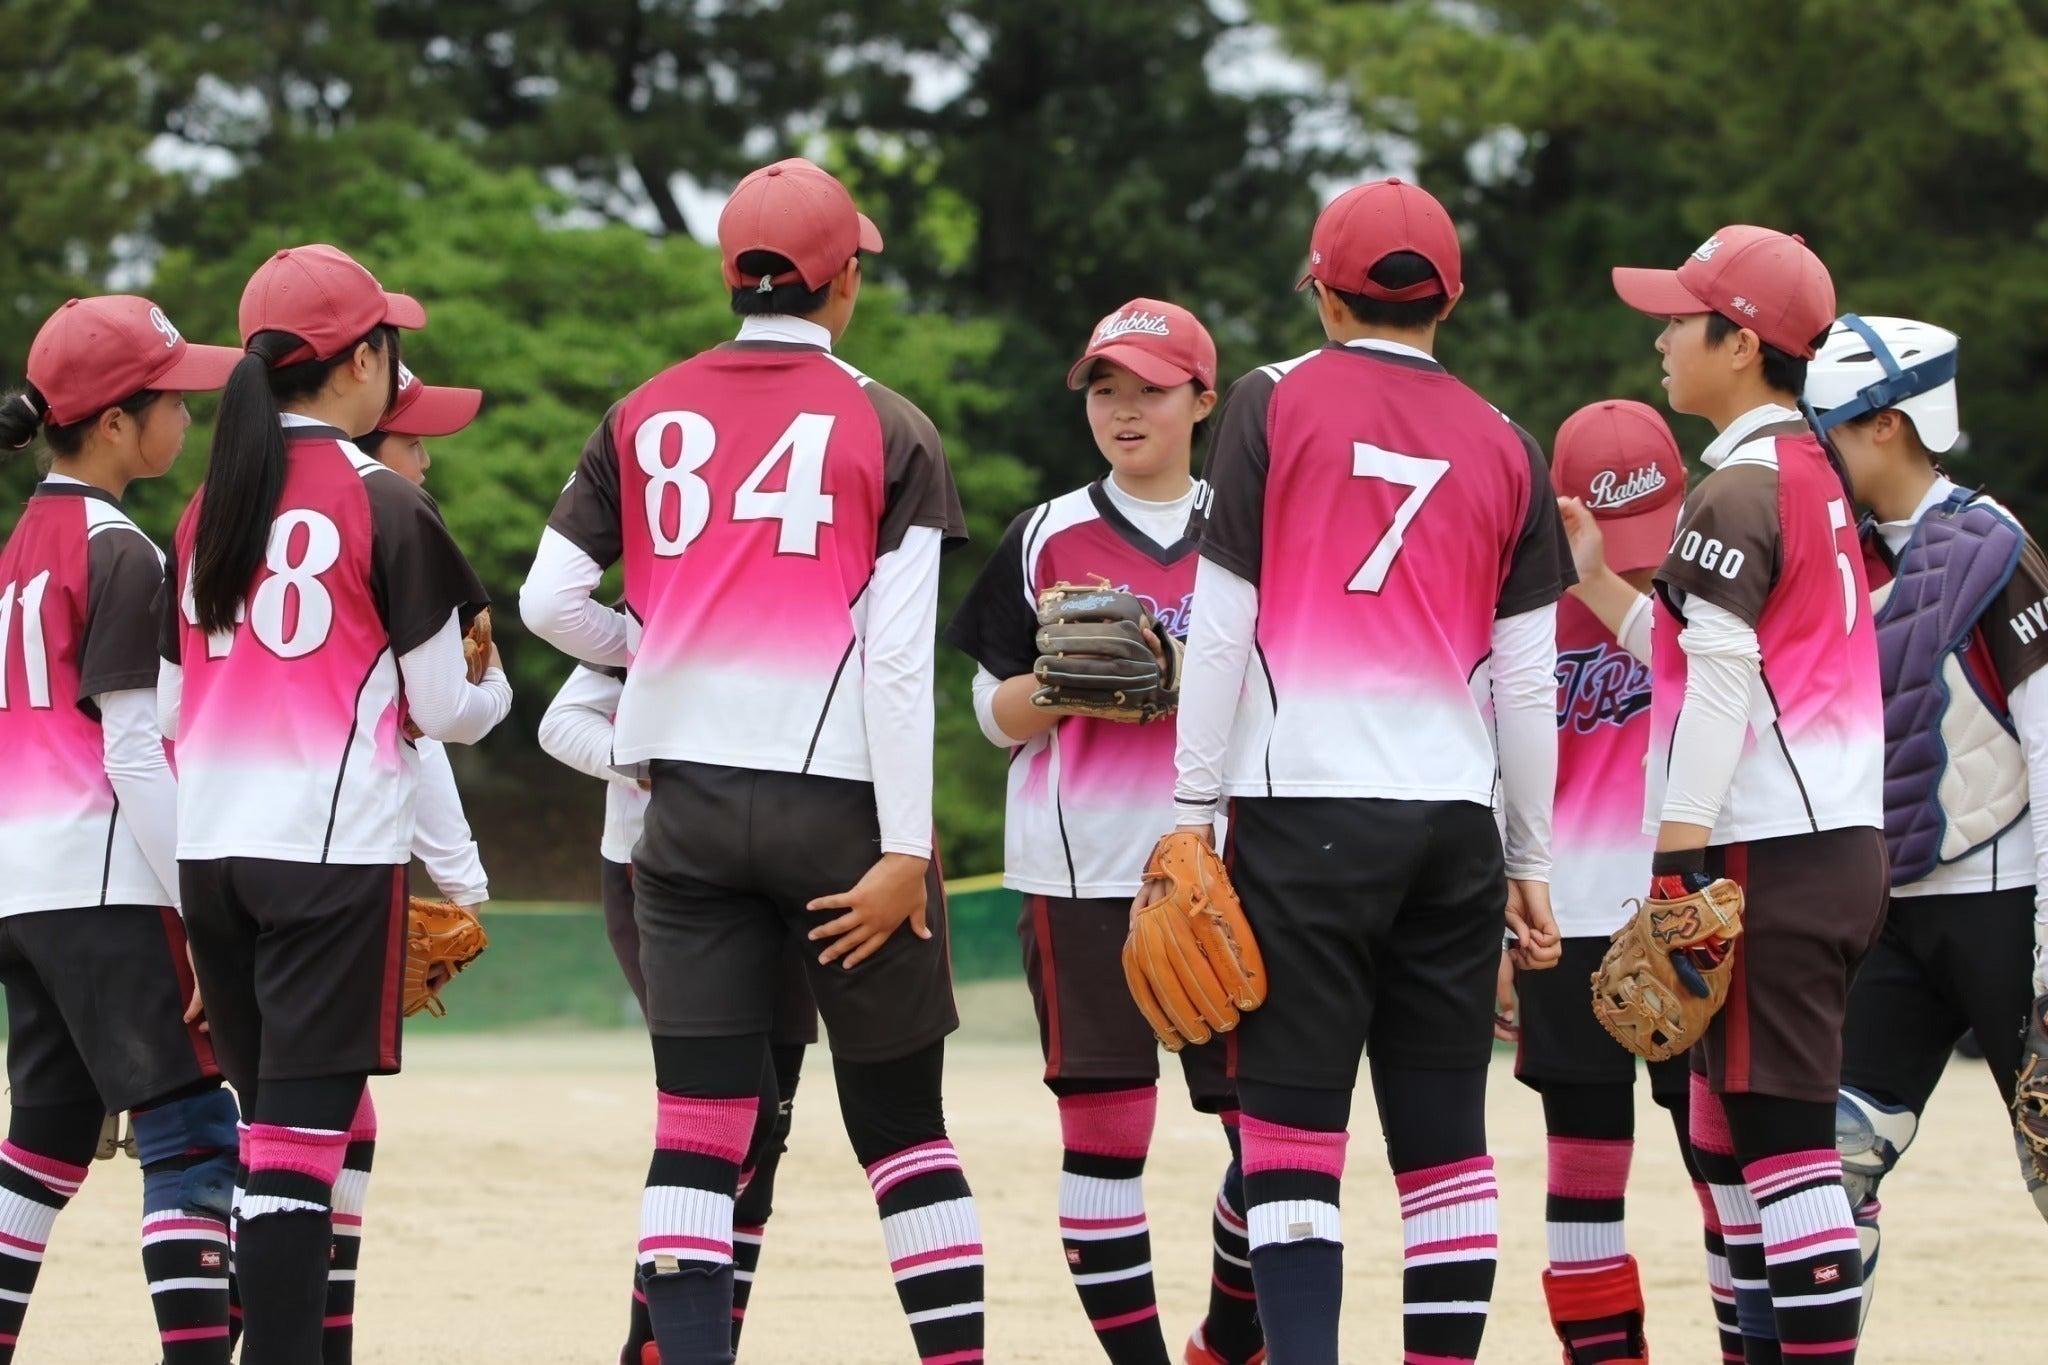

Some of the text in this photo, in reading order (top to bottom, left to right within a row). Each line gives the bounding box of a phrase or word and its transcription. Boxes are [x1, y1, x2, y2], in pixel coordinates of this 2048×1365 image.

[1092, 310, 1170, 348] Rabbits
[634, 410, 836, 557] 84
[1347, 441, 1451, 593] 7
[1586, 461, 1666, 508] Rabbits
